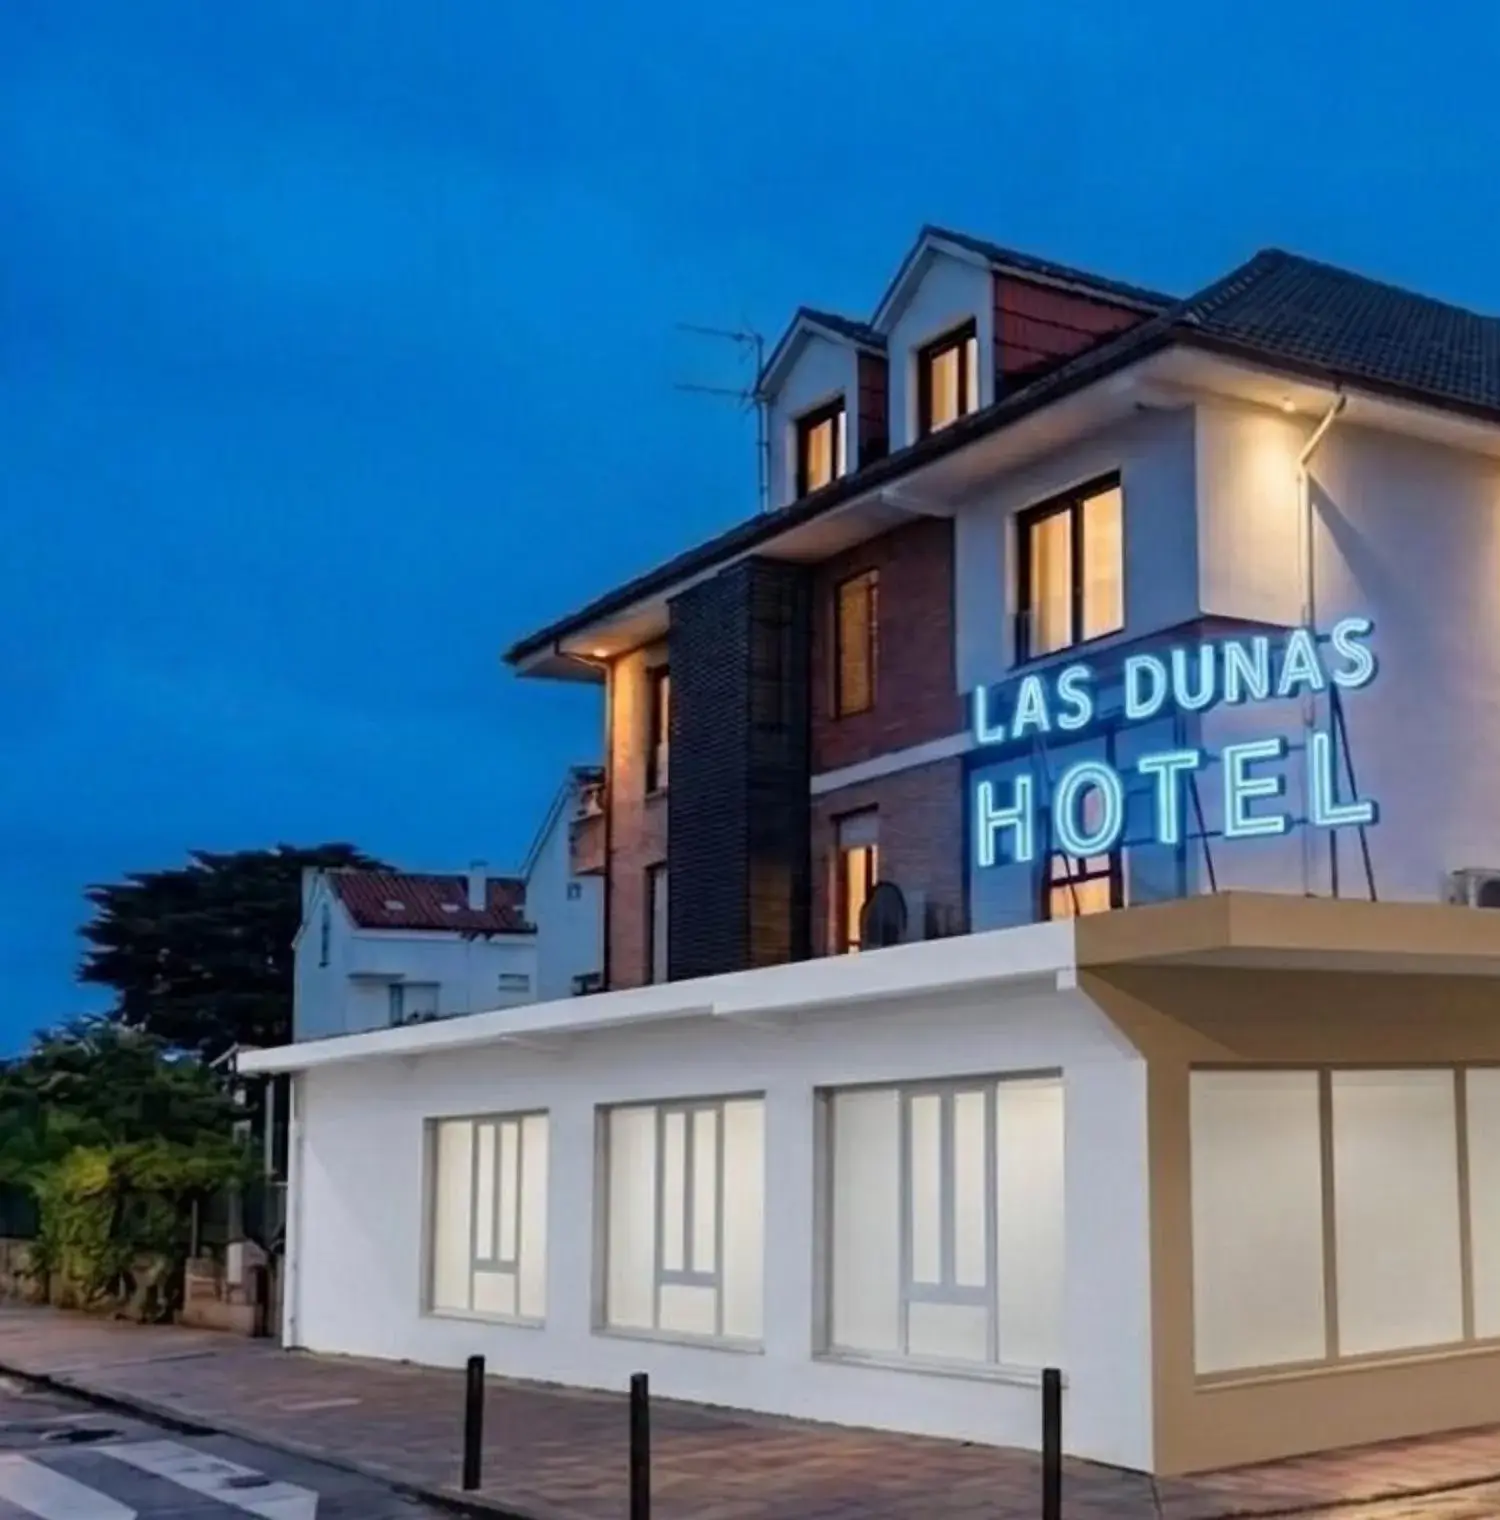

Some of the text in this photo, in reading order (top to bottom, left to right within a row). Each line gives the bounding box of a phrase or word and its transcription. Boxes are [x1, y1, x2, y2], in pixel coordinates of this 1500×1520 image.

[974, 617, 1376, 745] LAS DUNAS
[976, 731, 1376, 867] HOTEL
